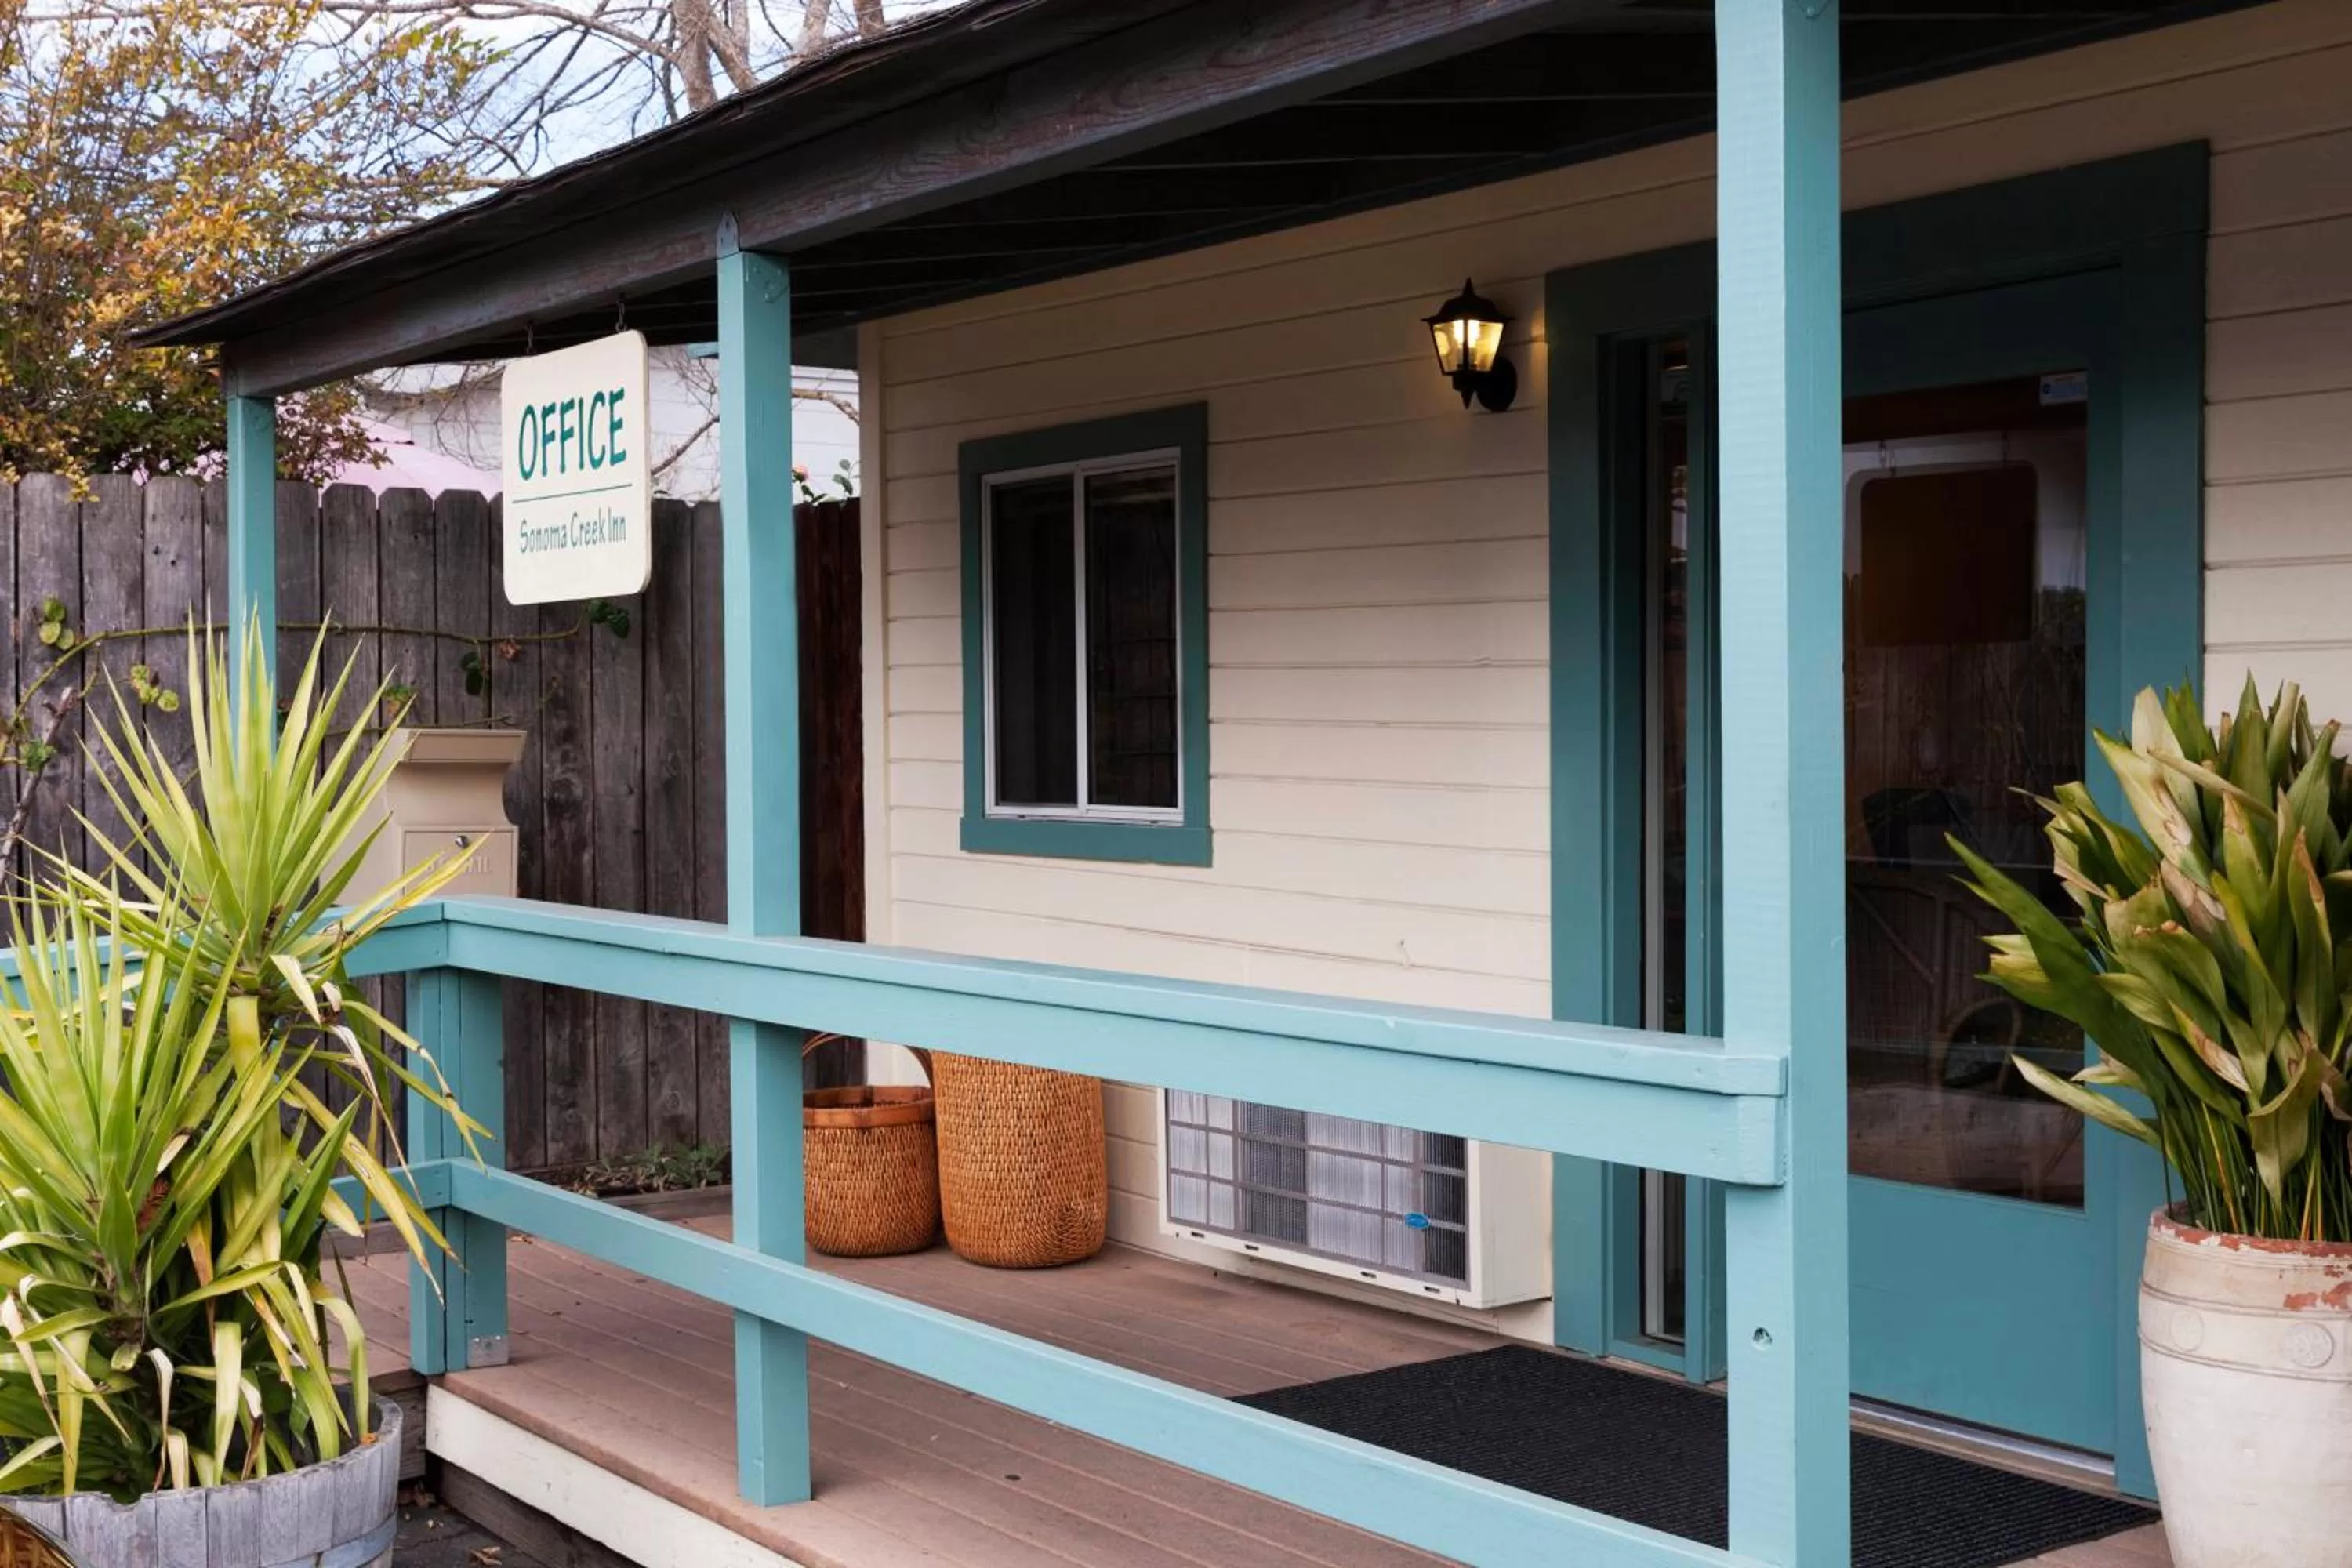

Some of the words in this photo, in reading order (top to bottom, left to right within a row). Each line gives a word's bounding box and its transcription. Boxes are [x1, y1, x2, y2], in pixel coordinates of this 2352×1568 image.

[518, 387, 627, 481] OFFICE
[520, 518, 567, 554] Sonoma
[570, 506, 605, 547] Creek
[608, 506, 626, 543] Inn
